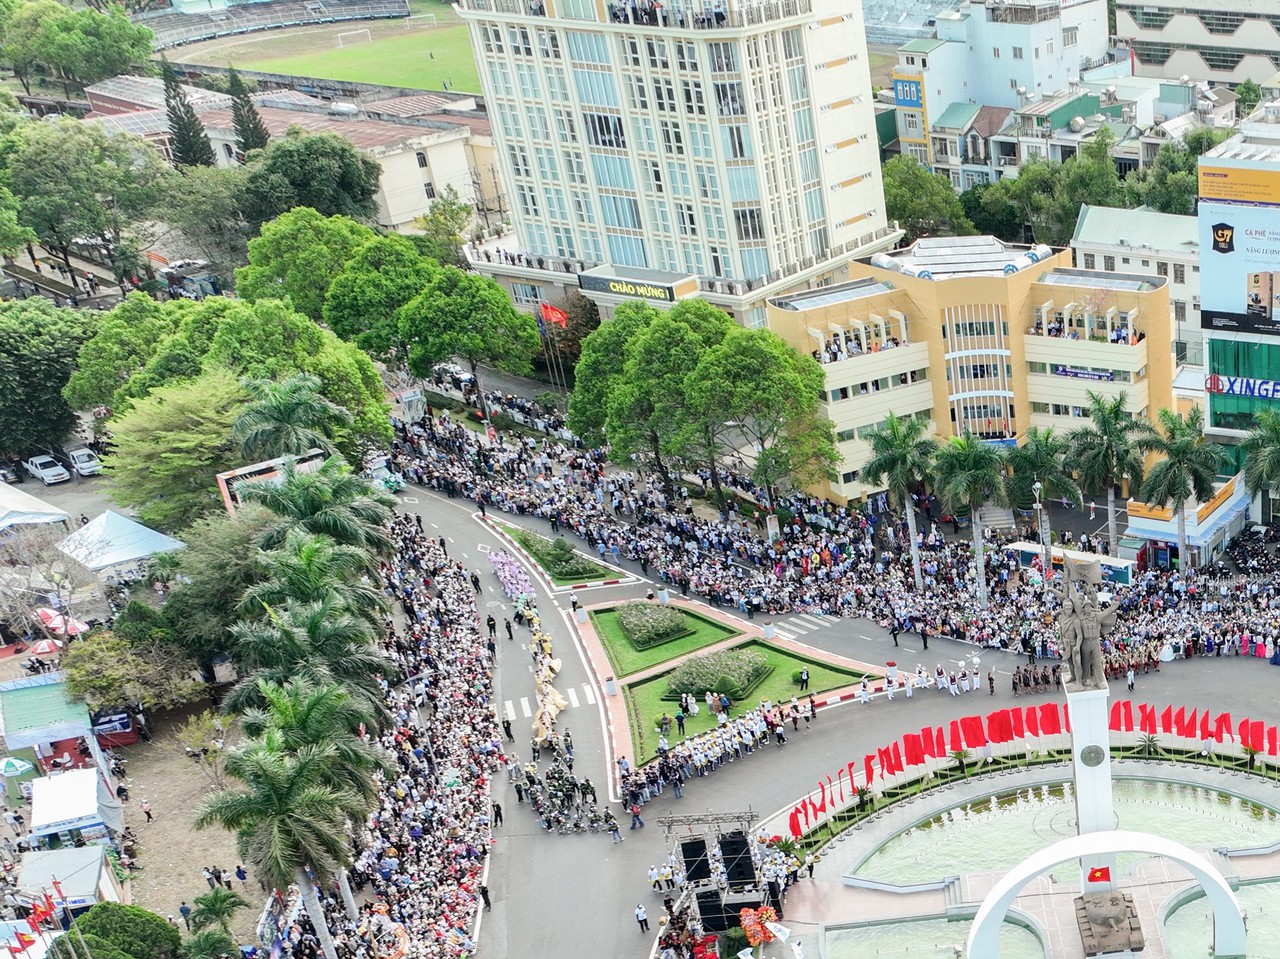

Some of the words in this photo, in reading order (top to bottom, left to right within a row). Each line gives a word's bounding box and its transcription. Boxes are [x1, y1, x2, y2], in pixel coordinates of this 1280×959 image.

[1214, 229, 1232, 243] G7
[1245, 228, 1254, 236] CÀ
[610, 281, 635, 294] CHÀO
[637, 284, 665, 299] MỪNG
